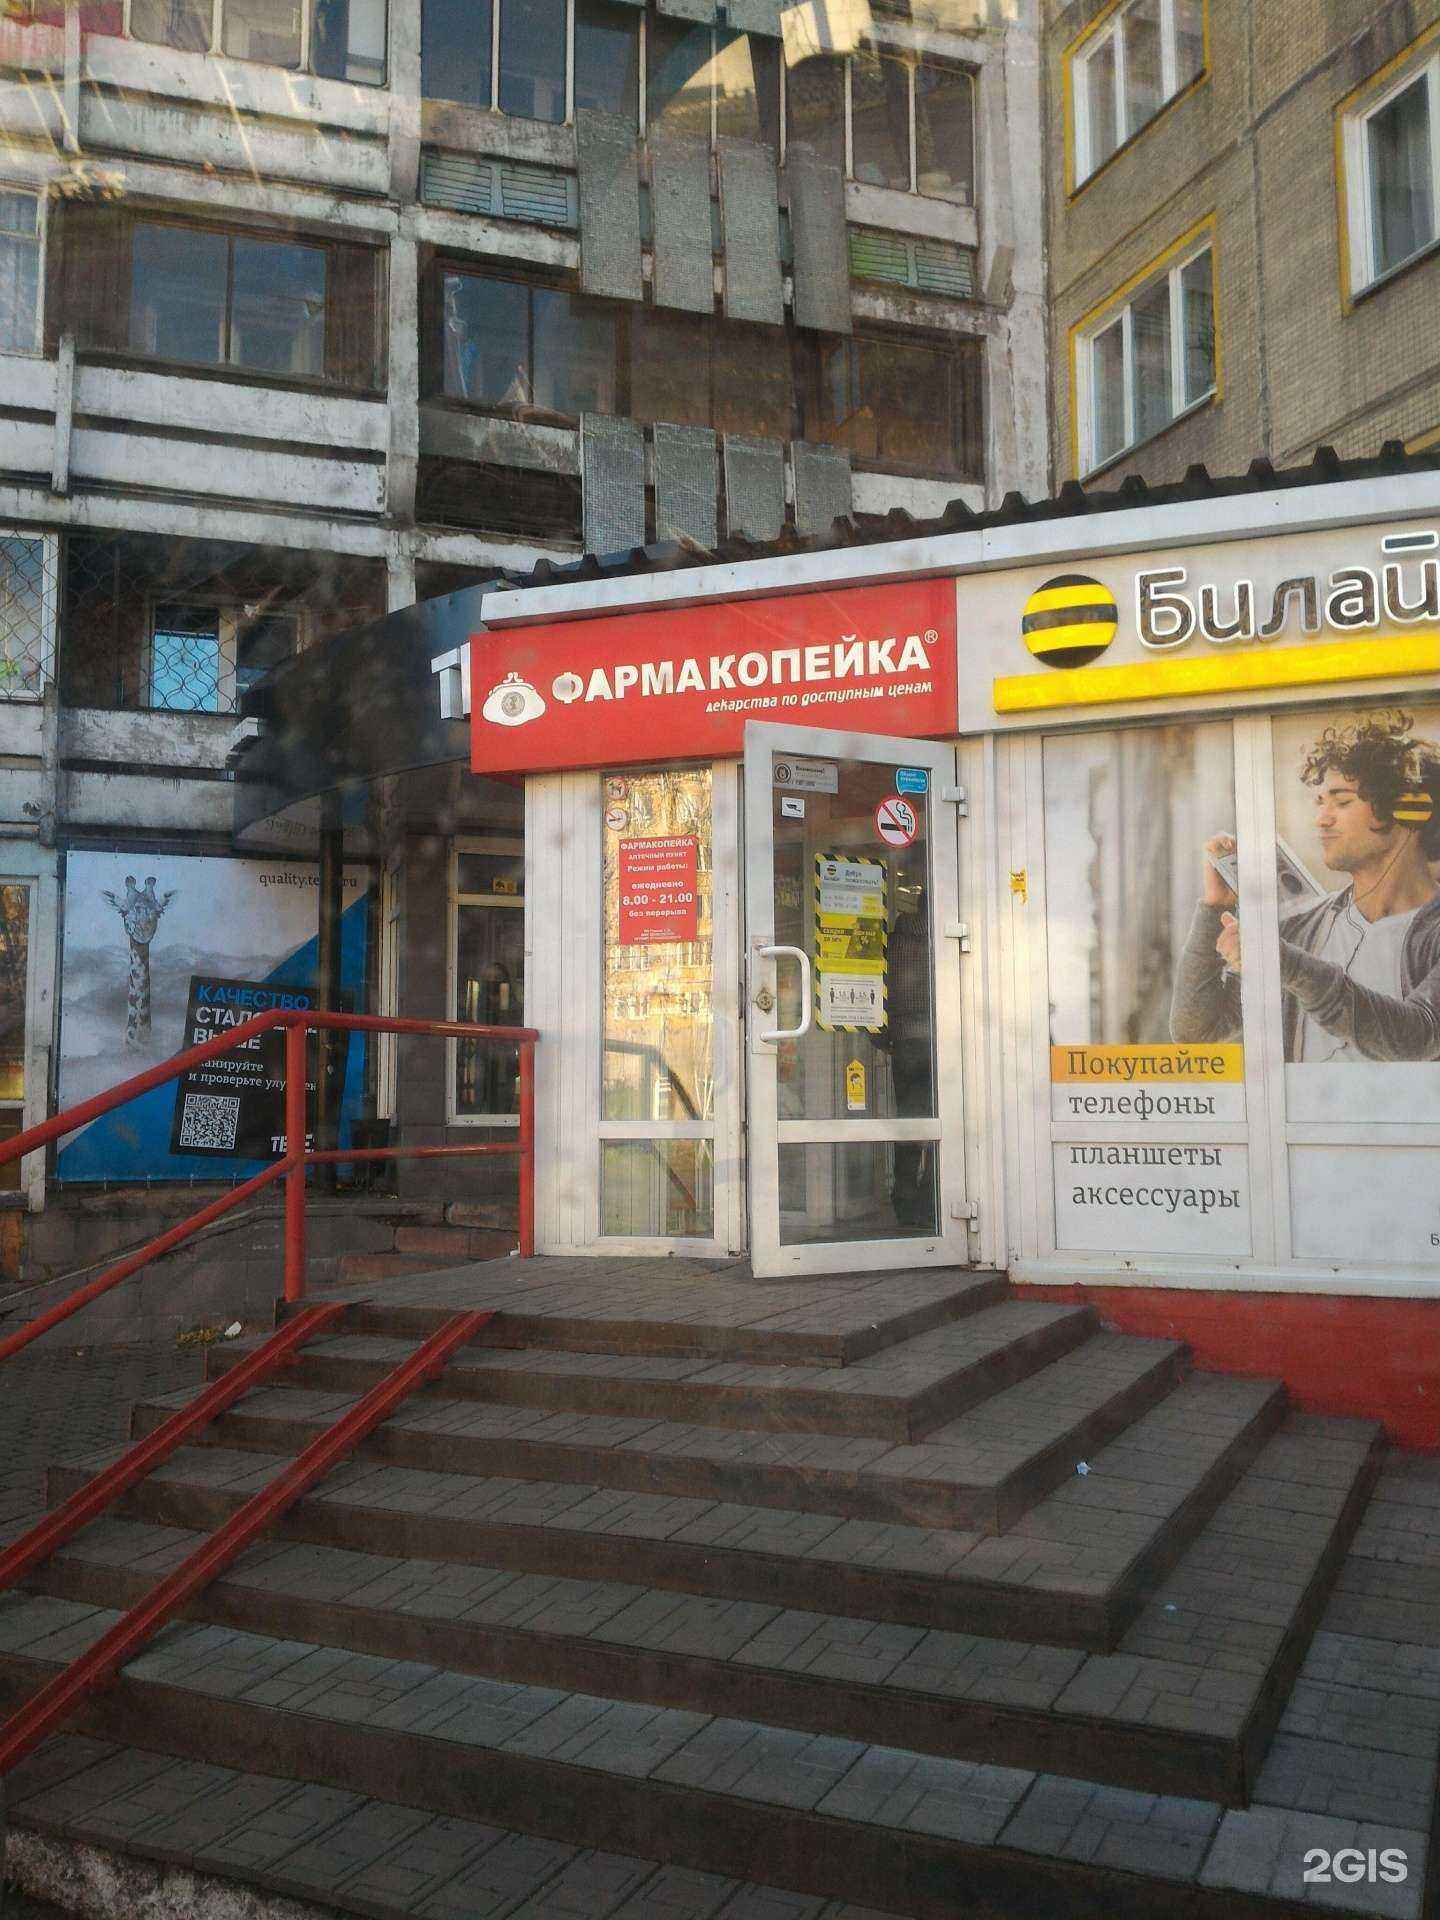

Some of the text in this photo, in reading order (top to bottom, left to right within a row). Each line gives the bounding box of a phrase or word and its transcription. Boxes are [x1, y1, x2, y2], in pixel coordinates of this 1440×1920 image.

[1134, 530, 1440, 649] Билай
[705, 682, 933, 714] лекарства по доступным ценам
[658, 892, 693, 904] 21.00
[197, 984, 310, 1010] КАЧЕСТВО
[188, 1072, 197, 1081] и
[200, 1073, 262, 1088] проверьте
[1067, 1050, 1226, 1081] Покупайте
[1068, 1089, 1216, 1120] телефоны
[1070, 1146, 1223, 1167] планшеты
[1072, 1184, 1240, 1214] аксессуары
